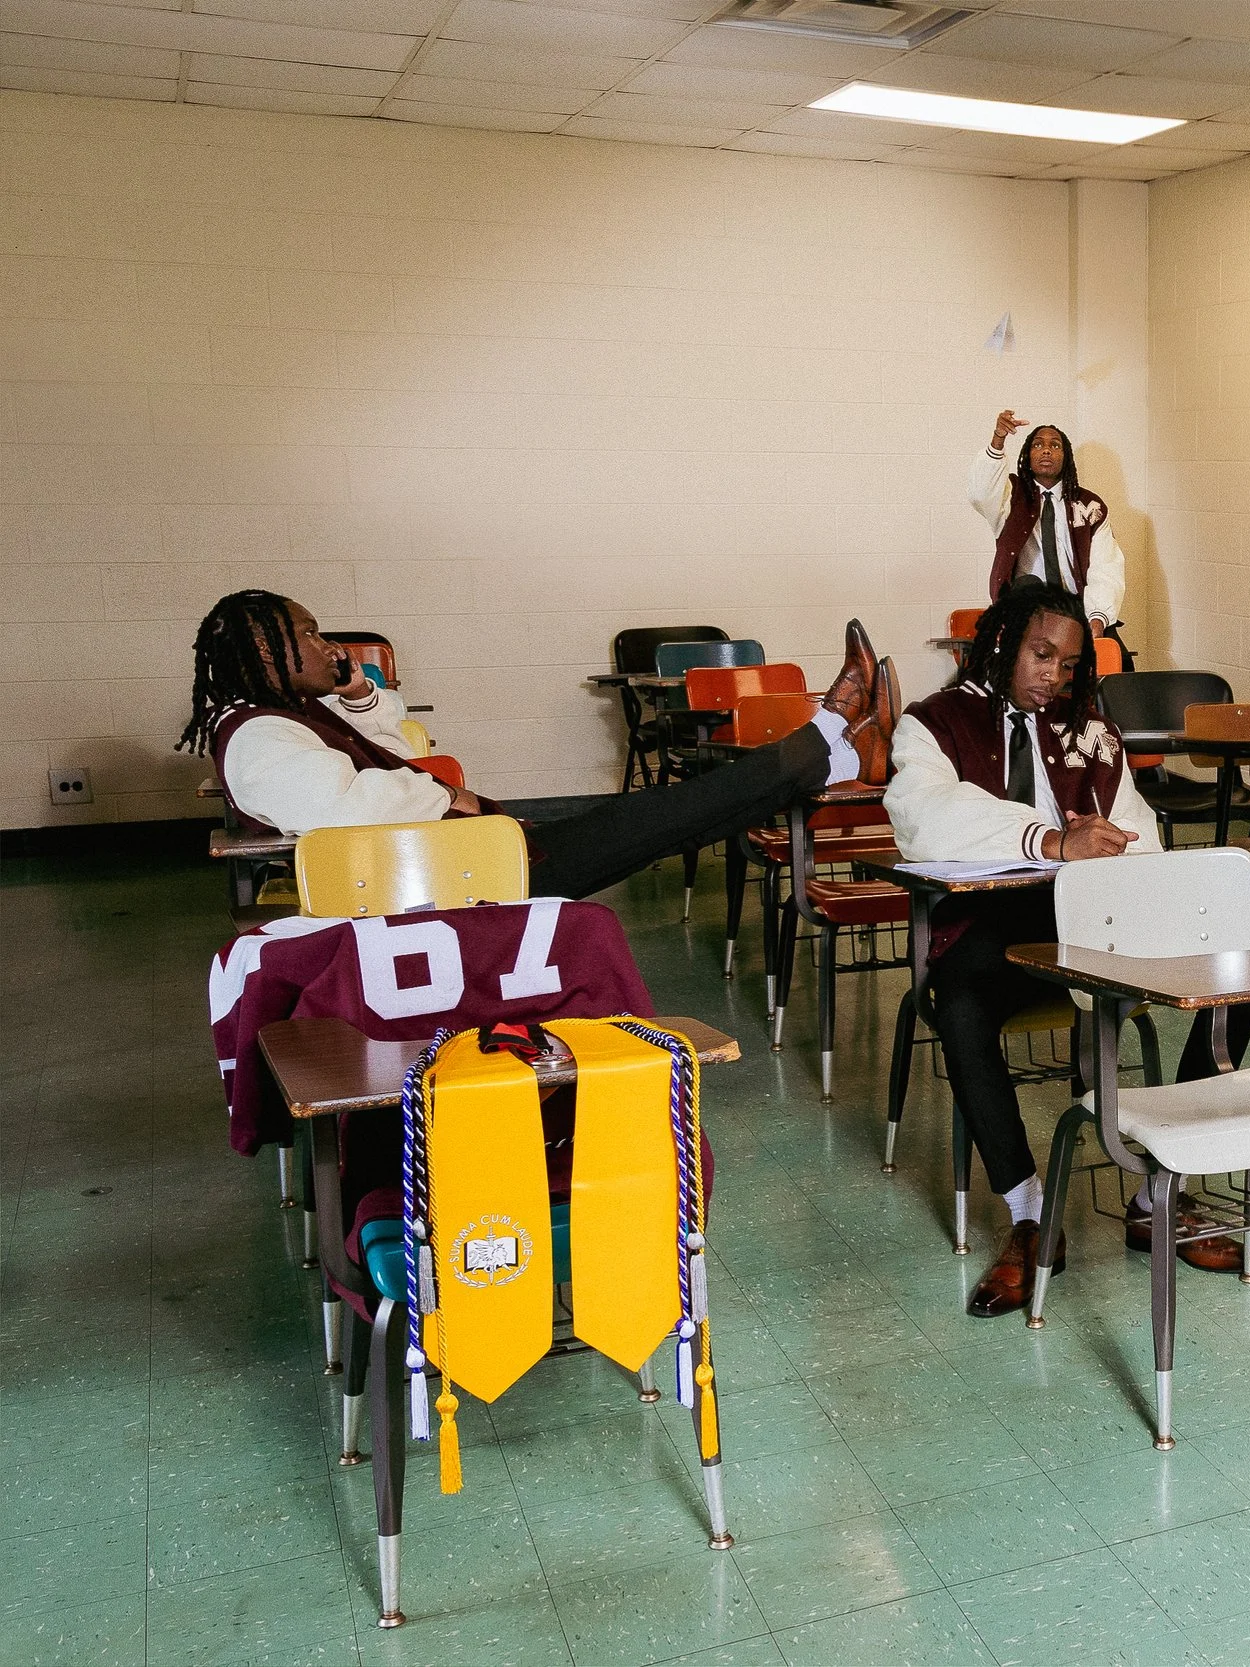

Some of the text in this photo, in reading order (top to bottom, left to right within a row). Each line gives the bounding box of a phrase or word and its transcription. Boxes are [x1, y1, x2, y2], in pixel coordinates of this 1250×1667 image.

[1071, 500, 1102, 528] M
[1050, 719, 1115, 769] M
[449, 1213, 534, 1264] SUMMA CUM LAUDE
